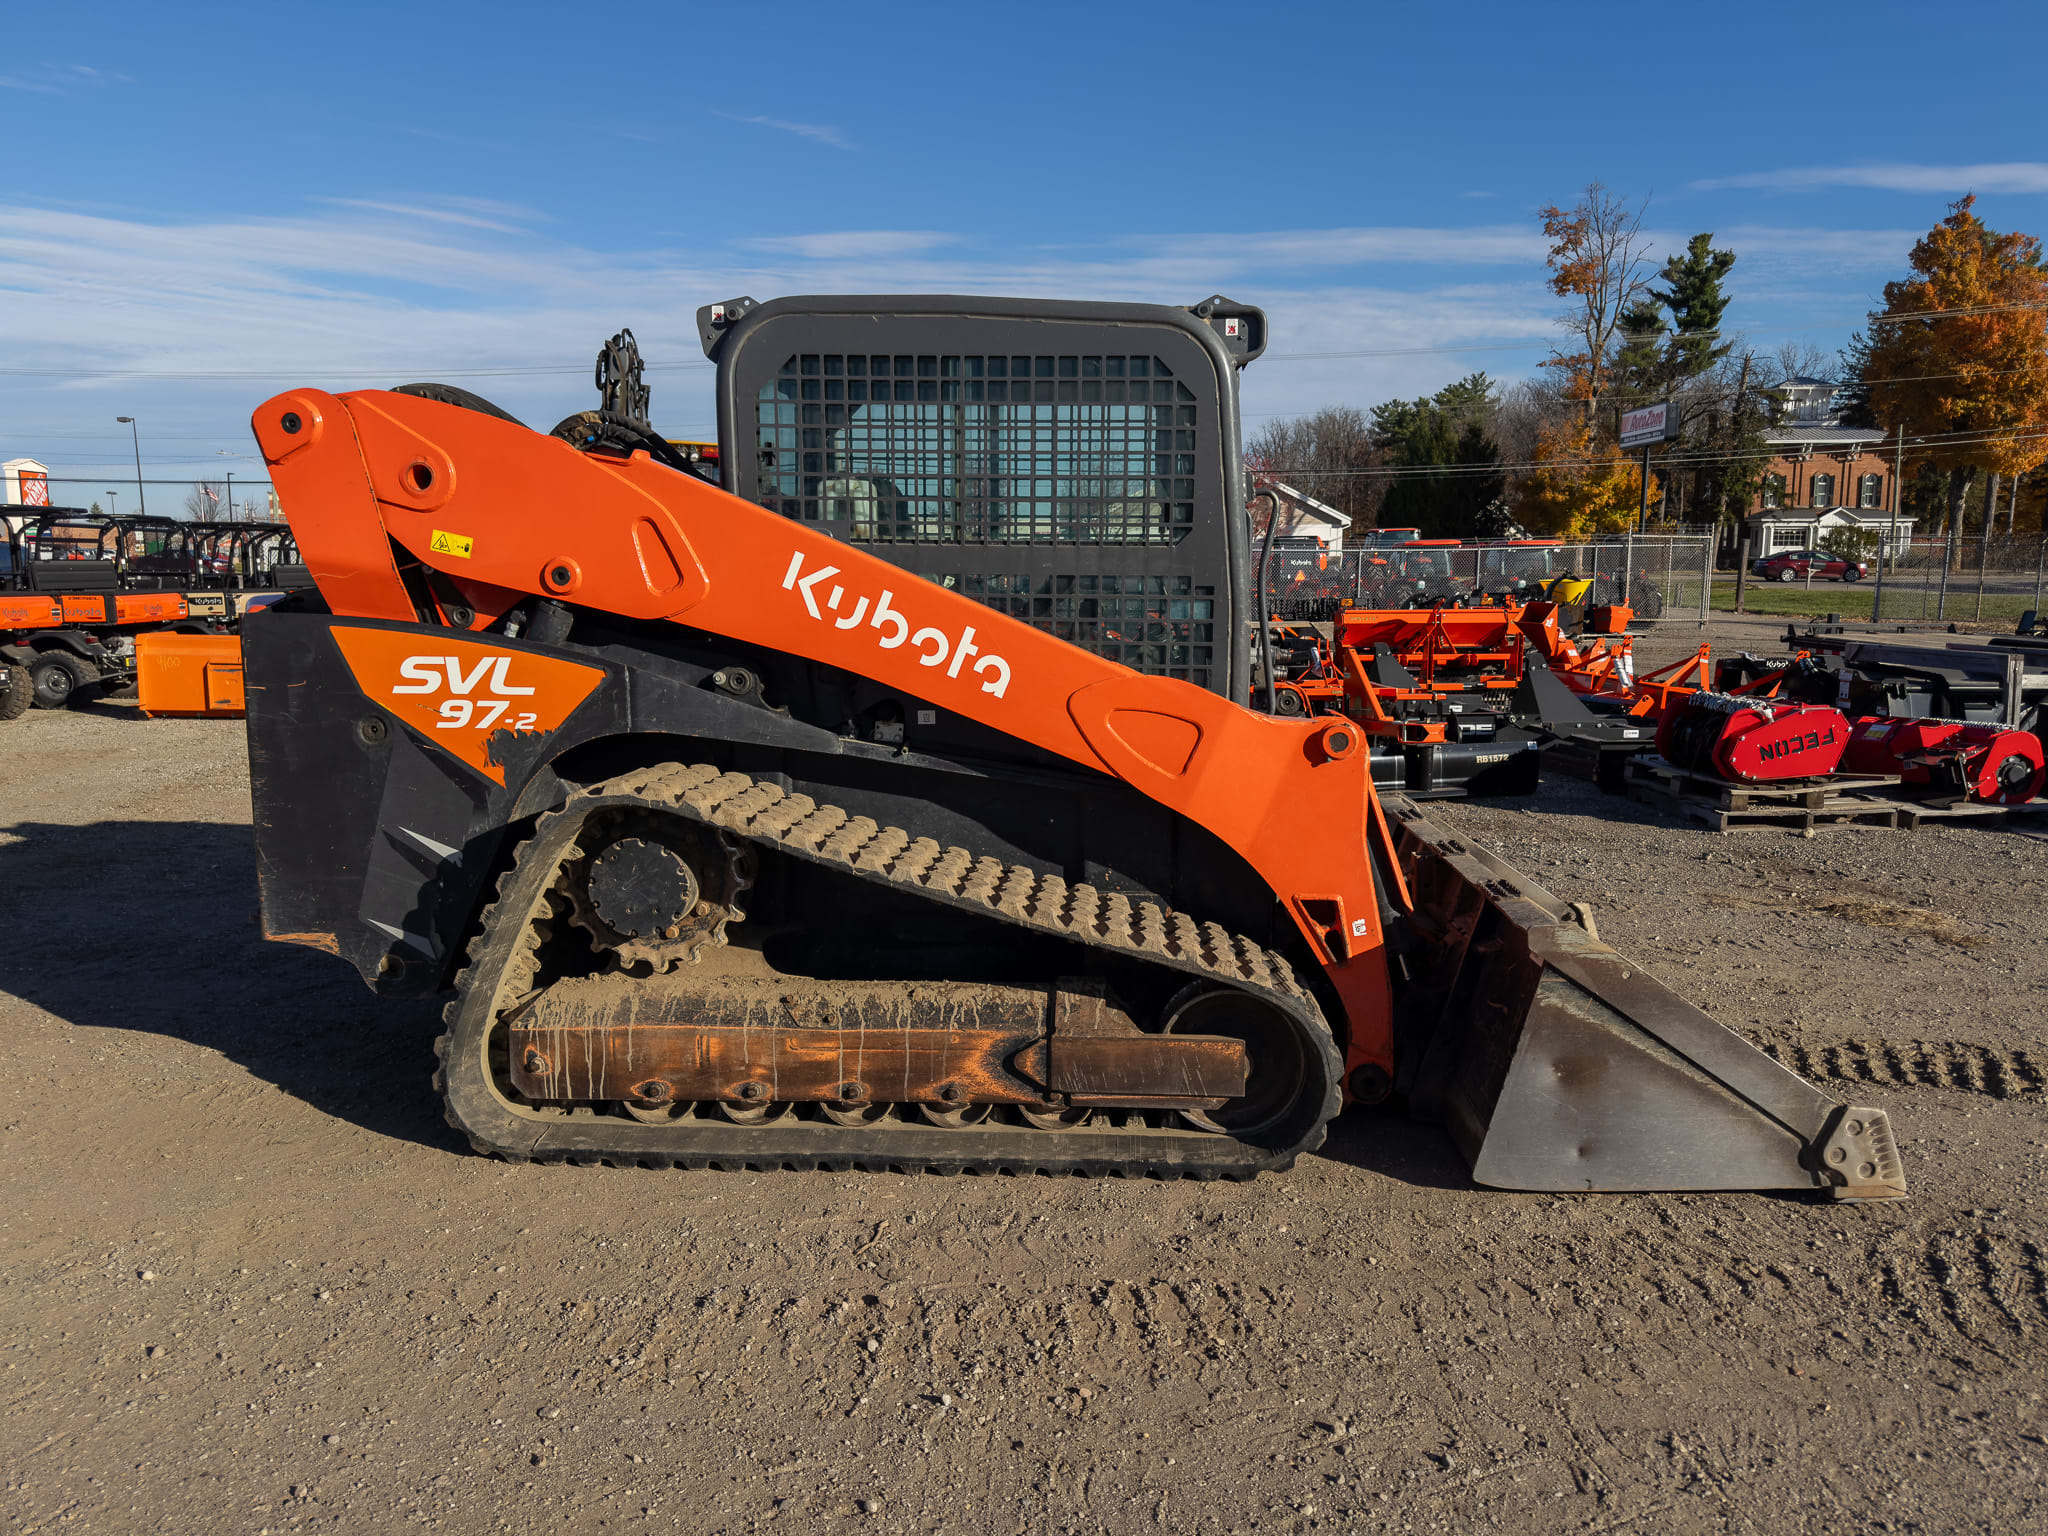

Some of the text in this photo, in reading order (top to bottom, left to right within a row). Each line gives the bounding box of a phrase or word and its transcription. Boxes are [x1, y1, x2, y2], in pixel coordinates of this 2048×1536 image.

[195, 597, 222, 605] Kubota
[782, 551, 1011, 699] Kubota
[392, 656, 536, 695] SVL
[436, 700, 537, 730] 97-2
[1476, 753, 1510, 764] RB1572
[1760, 728, 1835, 762] FECON
